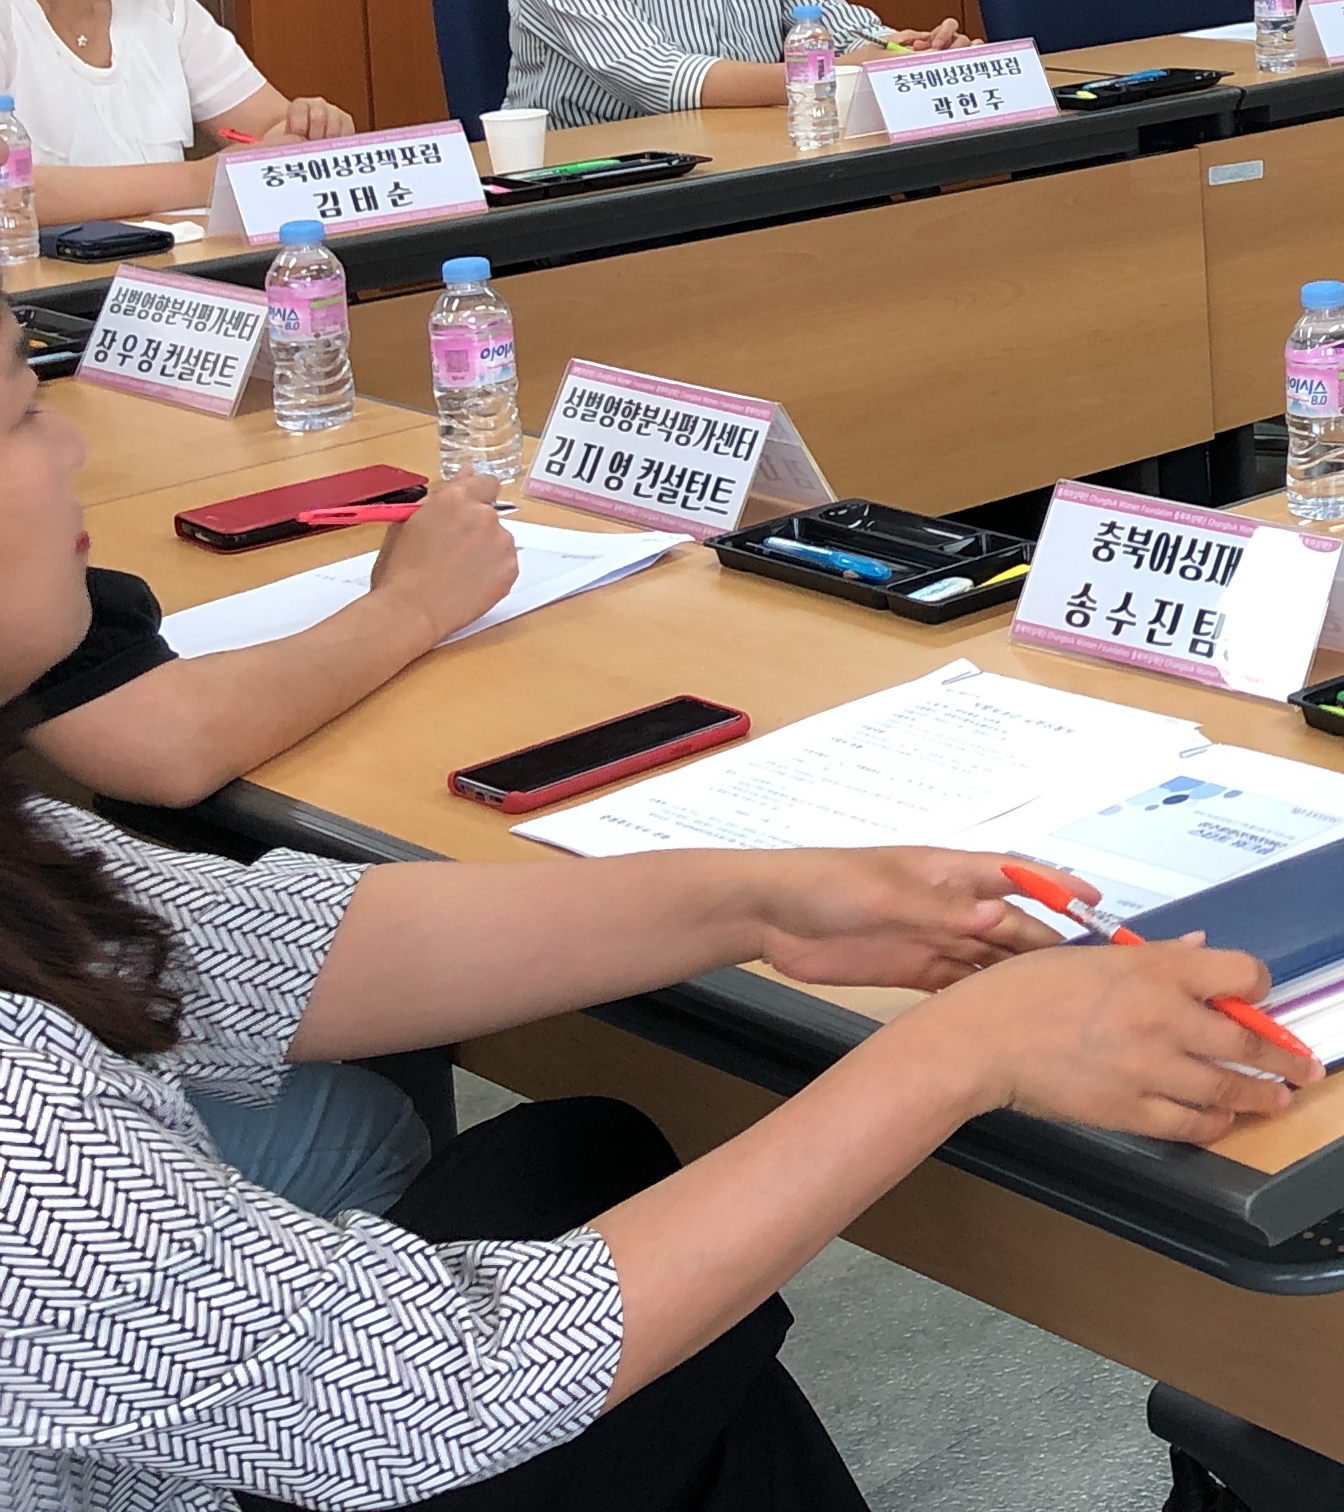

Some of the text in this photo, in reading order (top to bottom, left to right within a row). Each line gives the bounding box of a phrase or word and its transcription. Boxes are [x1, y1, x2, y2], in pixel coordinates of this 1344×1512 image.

[893, 57, 1022, 93] 충북여성정책포럼
[260, 142, 443, 188] 충북여성정책포럼
[109, 286, 261, 343] 성별영향분석평가센터
[159, 342, 240, 388] 컨설턴트
[560, 385, 761, 464] 성별영향분석평가센터
[1310, 394, 1328, 406] 8.0
[633, 456, 738, 517] 컨설턴트
[1091, 520, 1244, 589] 충북여성재
